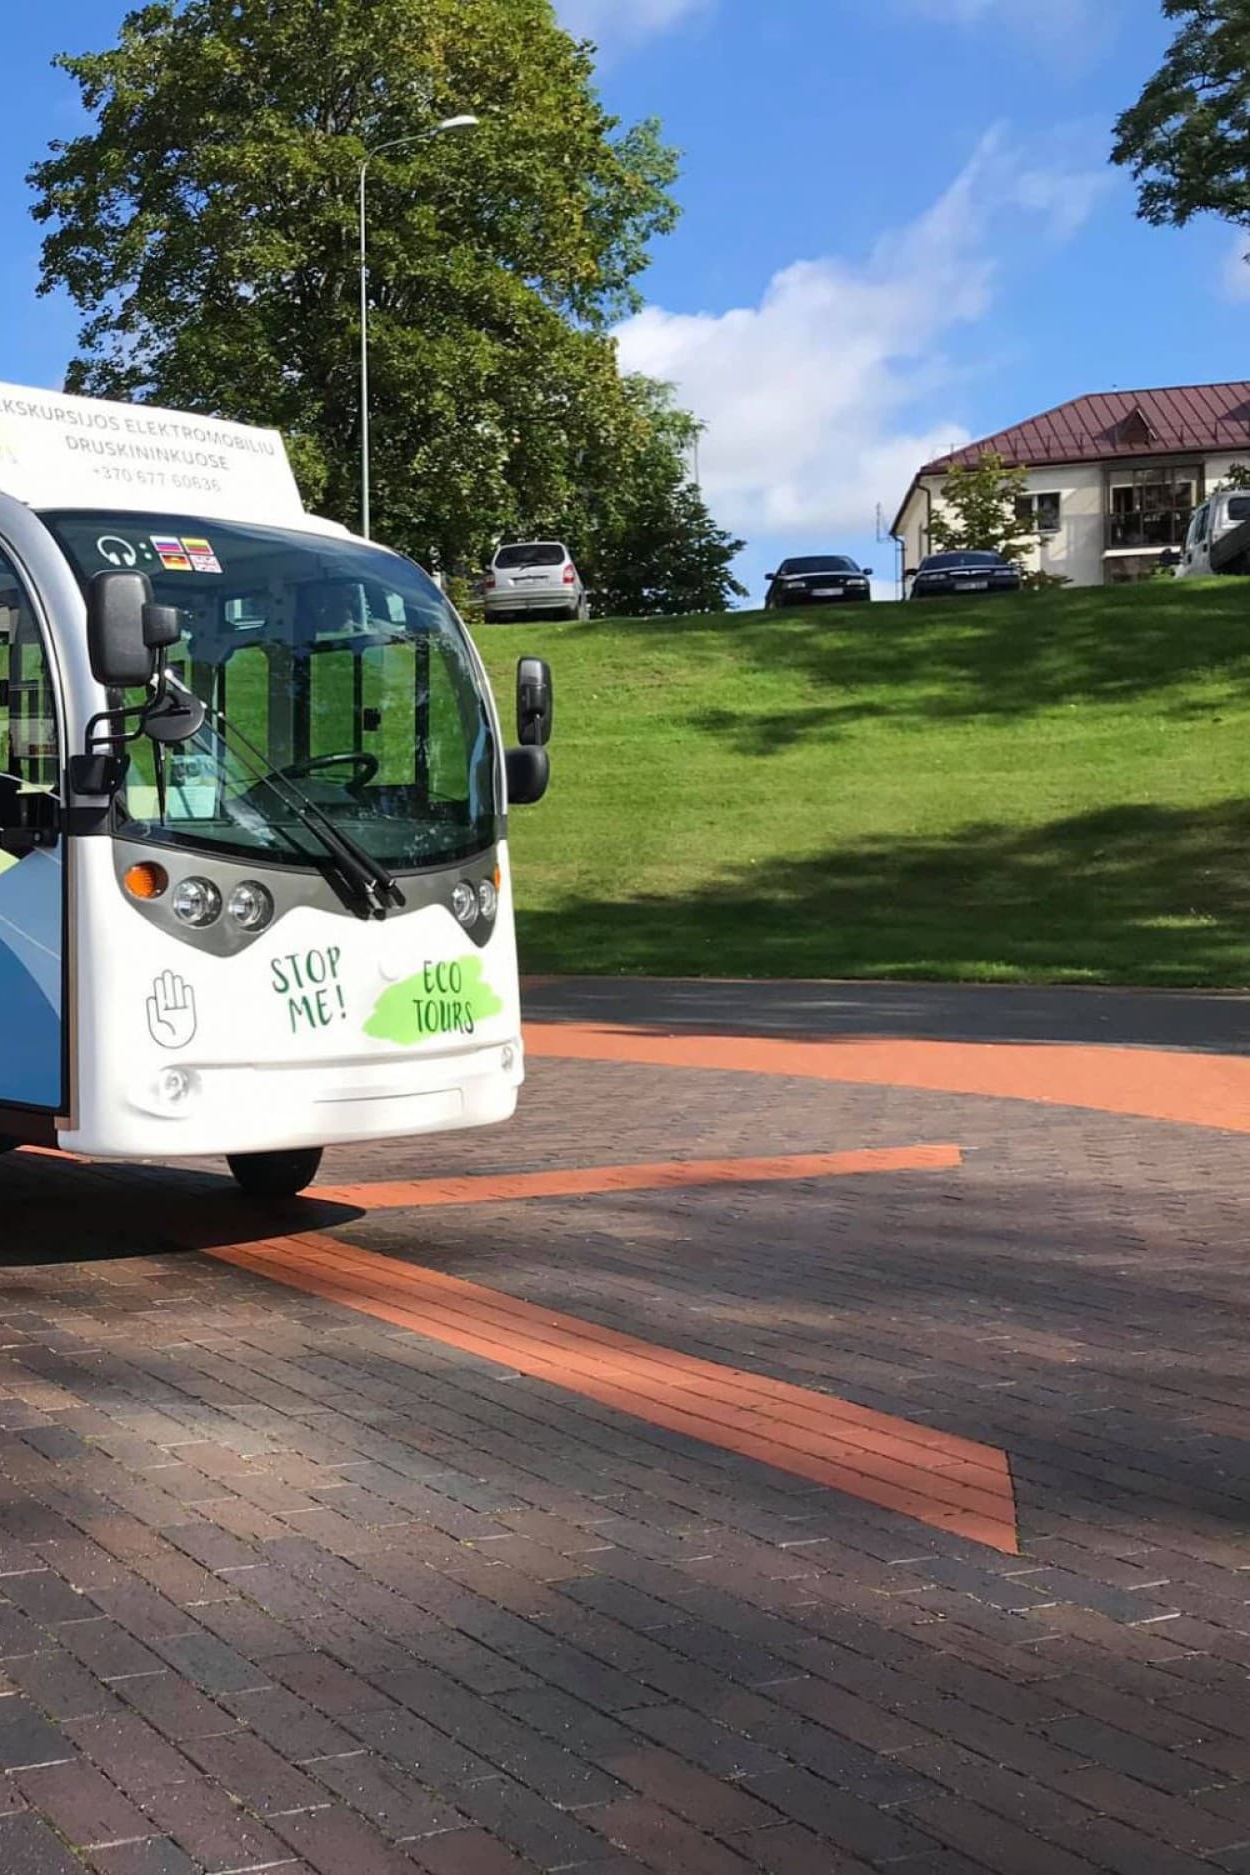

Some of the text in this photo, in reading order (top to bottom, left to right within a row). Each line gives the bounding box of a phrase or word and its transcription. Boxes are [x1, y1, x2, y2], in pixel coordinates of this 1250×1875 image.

[65, 435, 231, 470] DRUSKININKUOSE
[125, 418, 275, 456] ELEKTROMOBILIU
[93, 465, 133, 483] +370
[137, 470, 166, 486] 677
[270, 946, 341, 993] STOP
[423, 960, 462, 994] ECO
[288, 984, 347, 1033] ME!
[413, 999, 475, 1034] TOURS
